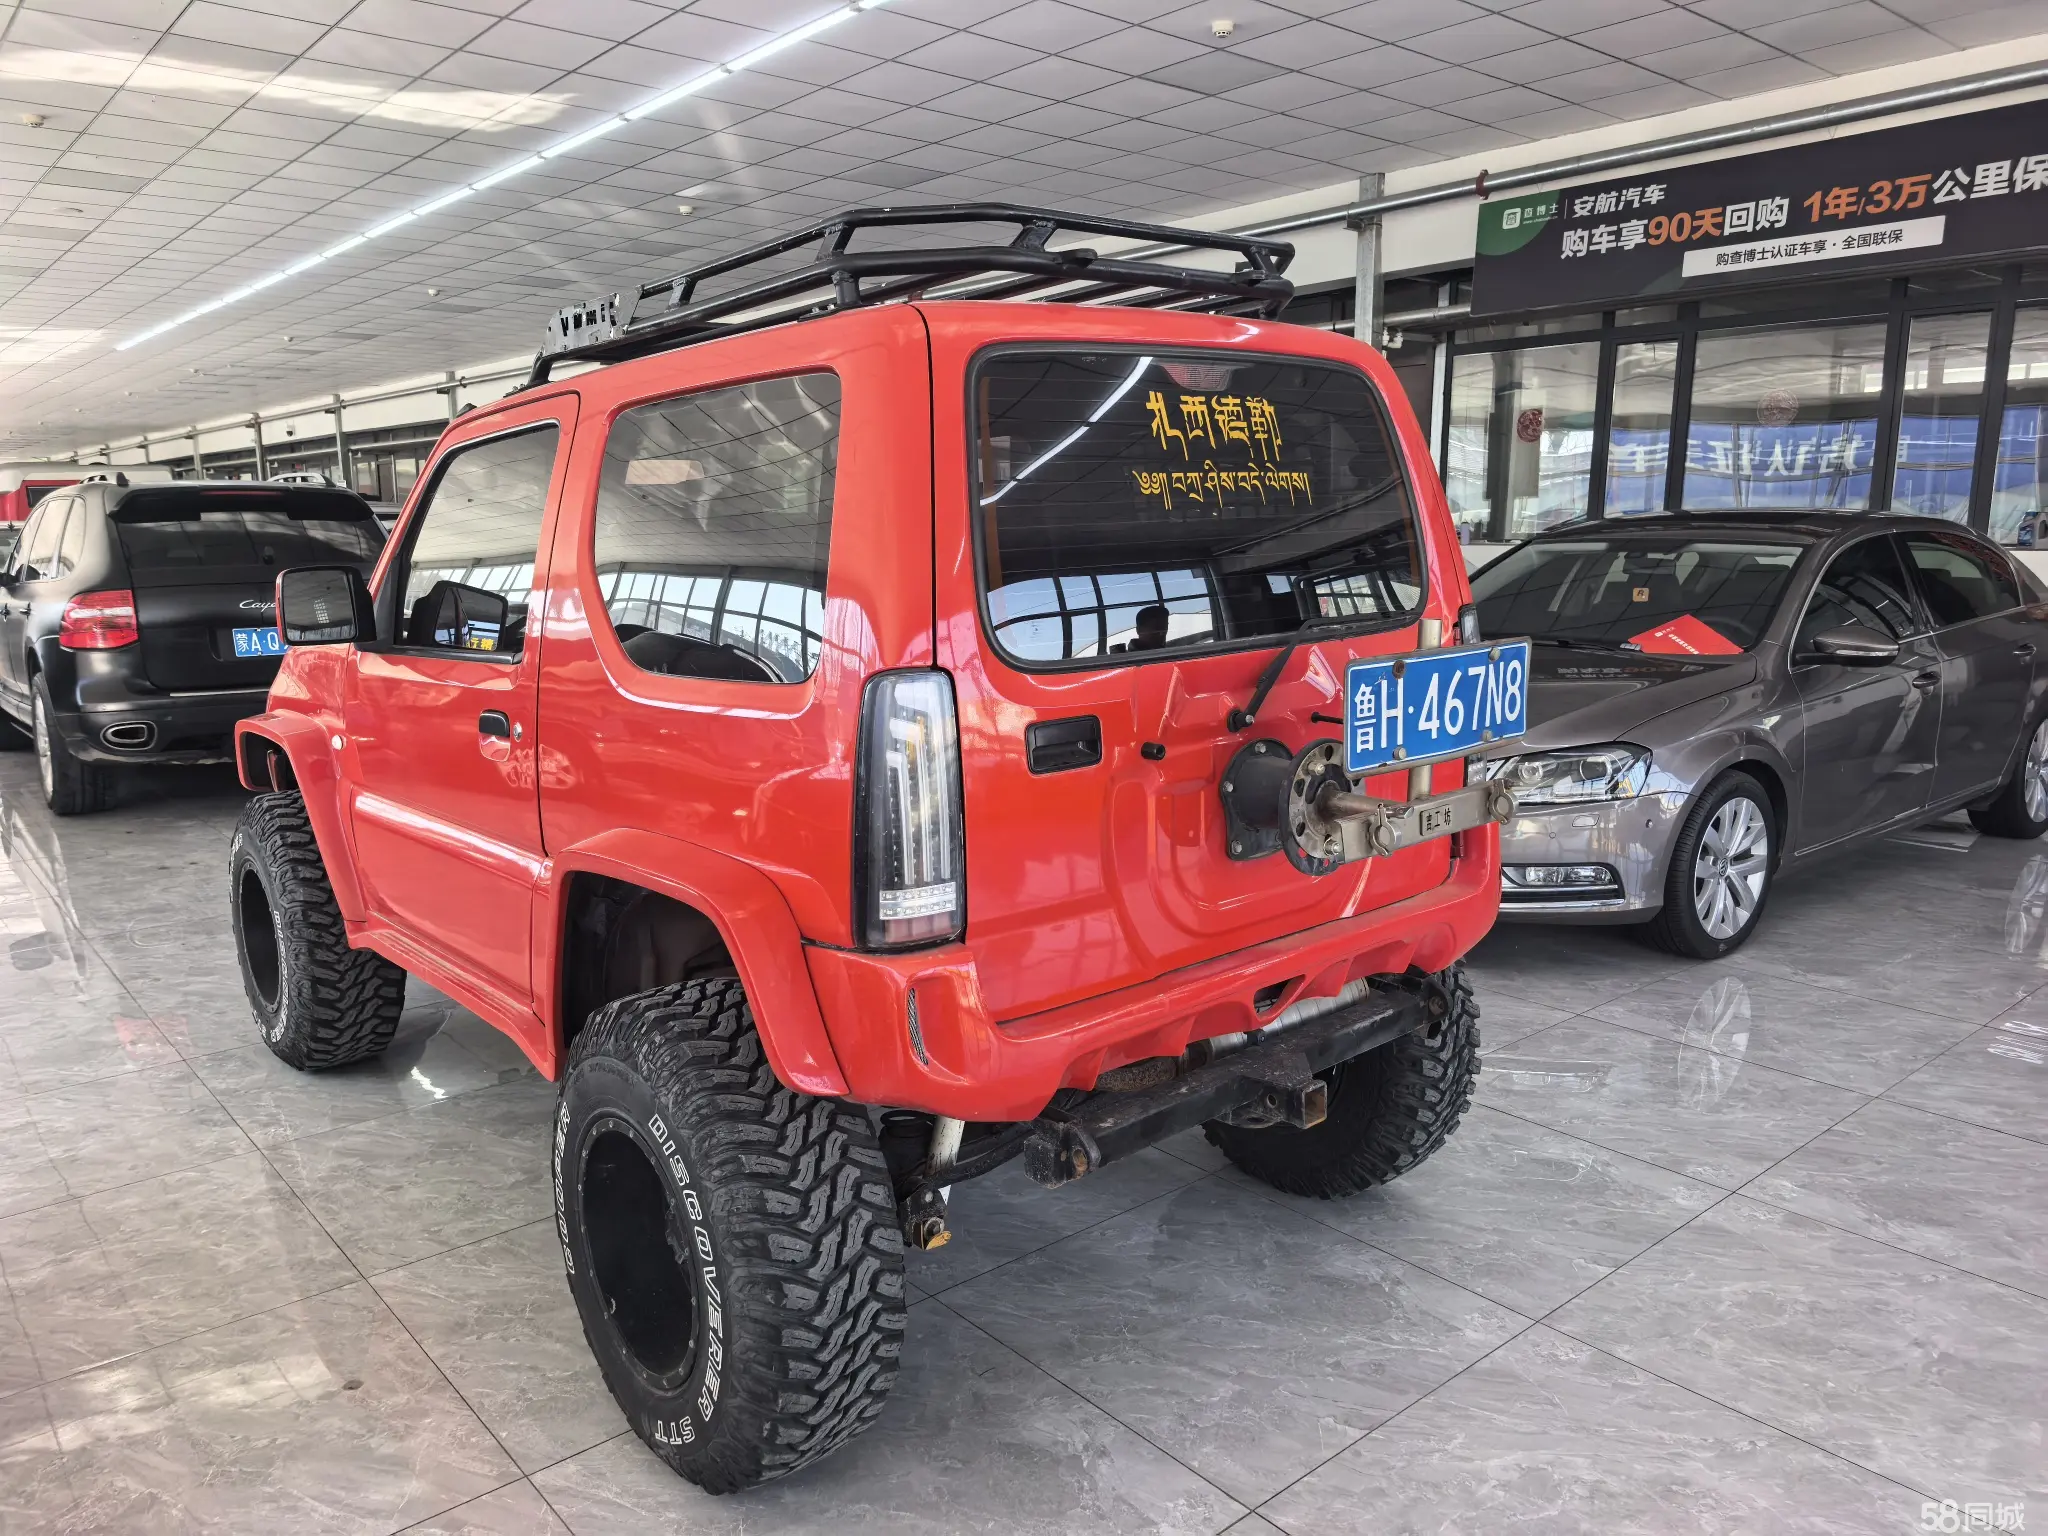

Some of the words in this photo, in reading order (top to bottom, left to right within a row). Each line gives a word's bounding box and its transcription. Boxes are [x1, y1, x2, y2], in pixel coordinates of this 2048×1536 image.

[1560, 196, 1790, 260] 购车享90天回购
[1571, 184, 1667, 219] 安航汽车
[1354, 659, 1522, 753] 鲁H·467N8
[553, 1101, 576, 1275] COOPER
[648, 1113, 724, 1422] DISCOVERER
[654, 1415, 697, 1446] STT
